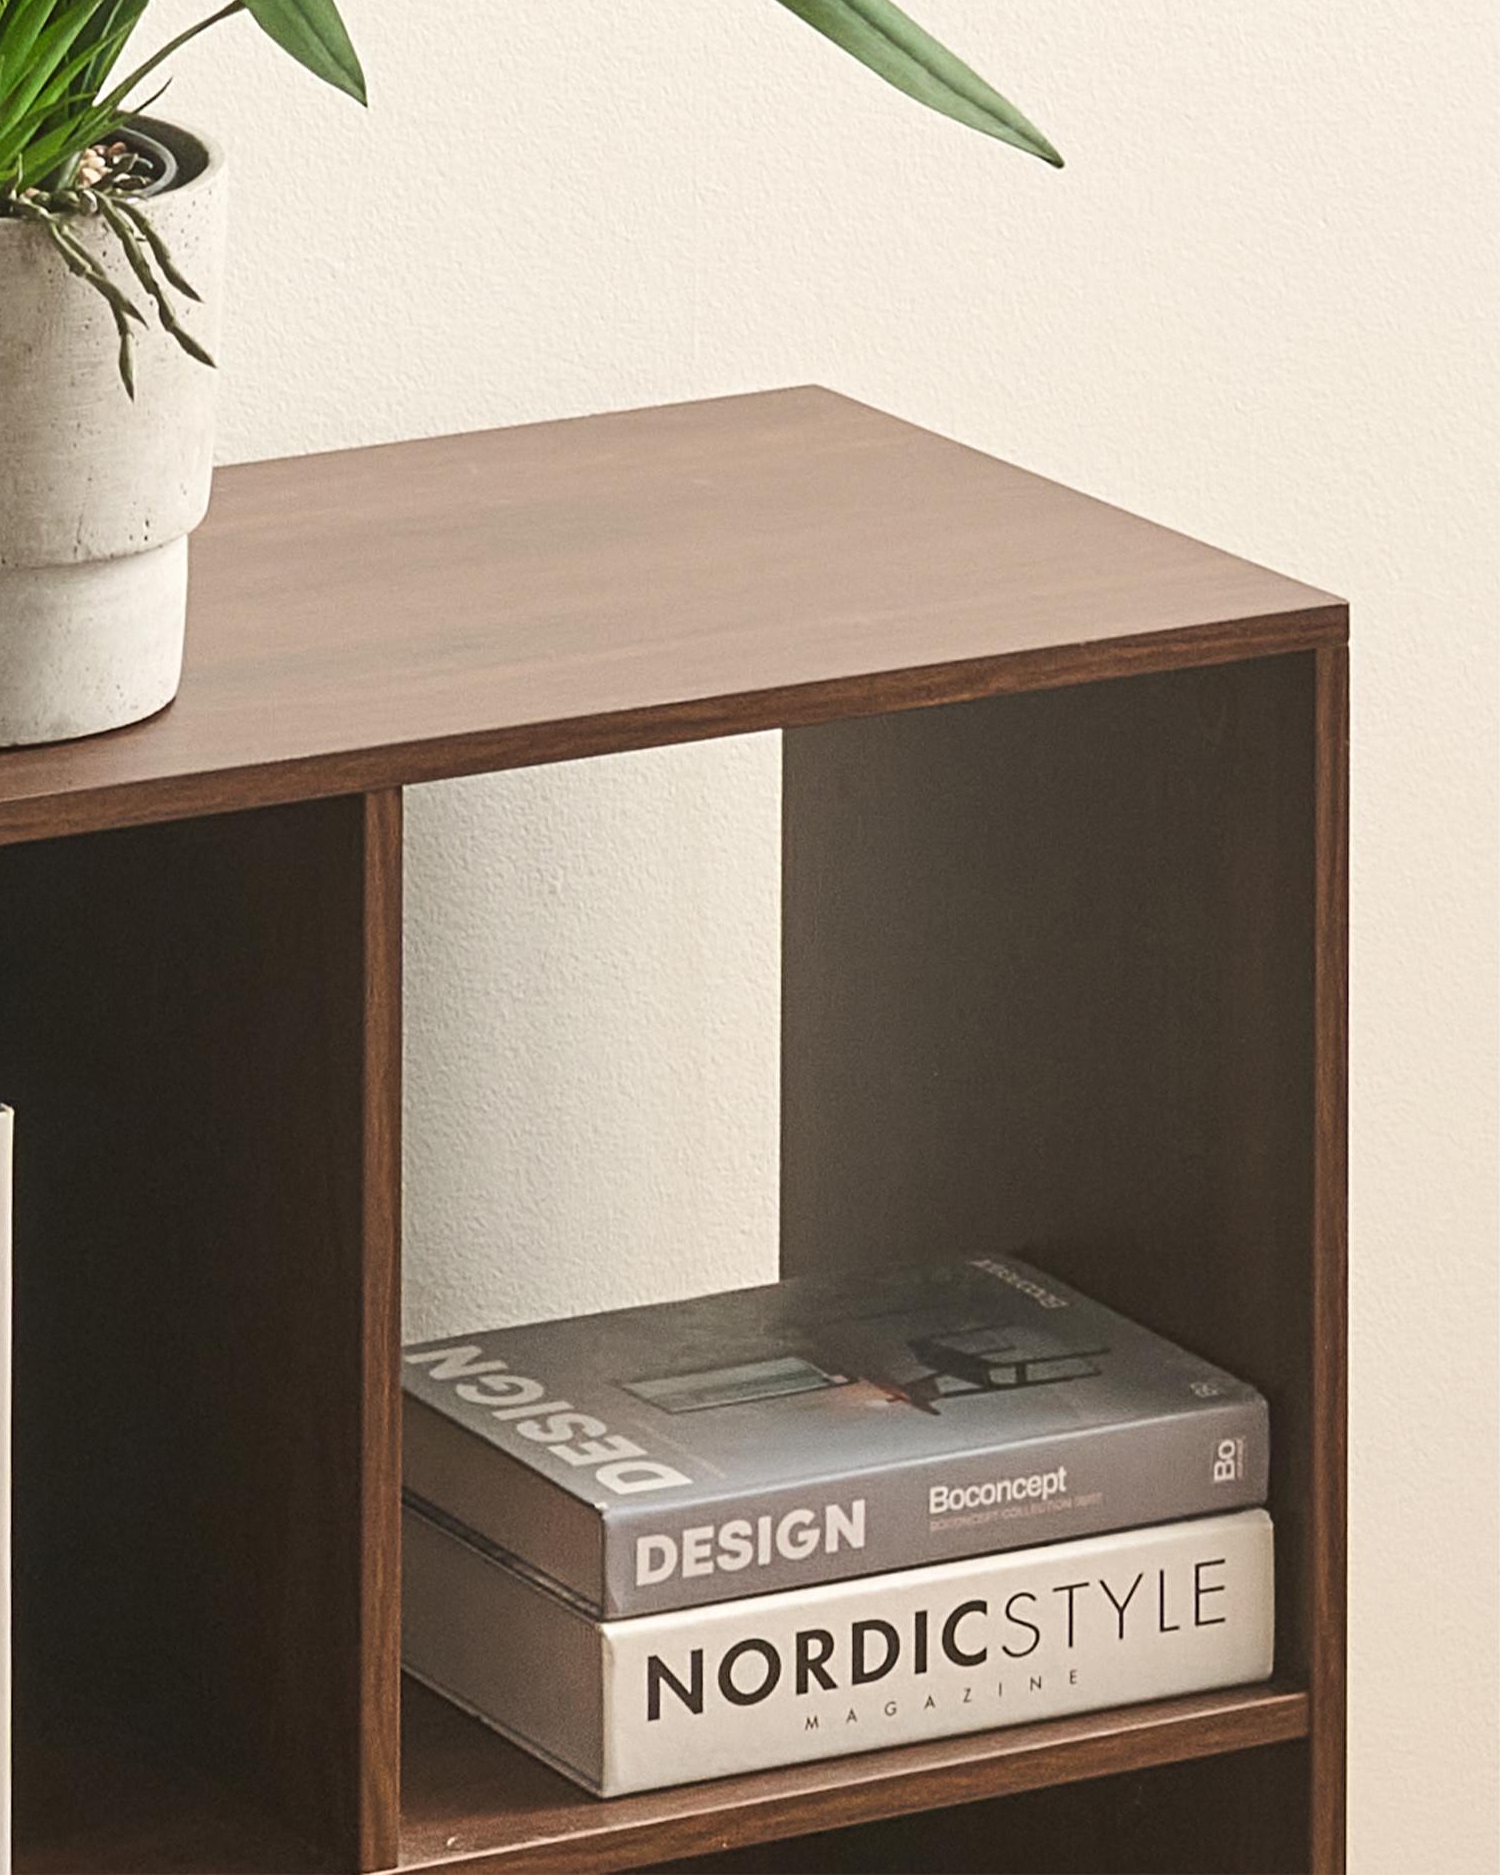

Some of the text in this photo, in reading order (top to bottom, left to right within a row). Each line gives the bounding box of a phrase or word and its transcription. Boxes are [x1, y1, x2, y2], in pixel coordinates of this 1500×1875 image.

[404, 1344, 694, 1495] DESIGN
[929, 1466, 1067, 1515] Boconcept
[636, 1499, 866, 1586] DESIGN
[804, 1669, 1079, 1731] MAGAZINE
